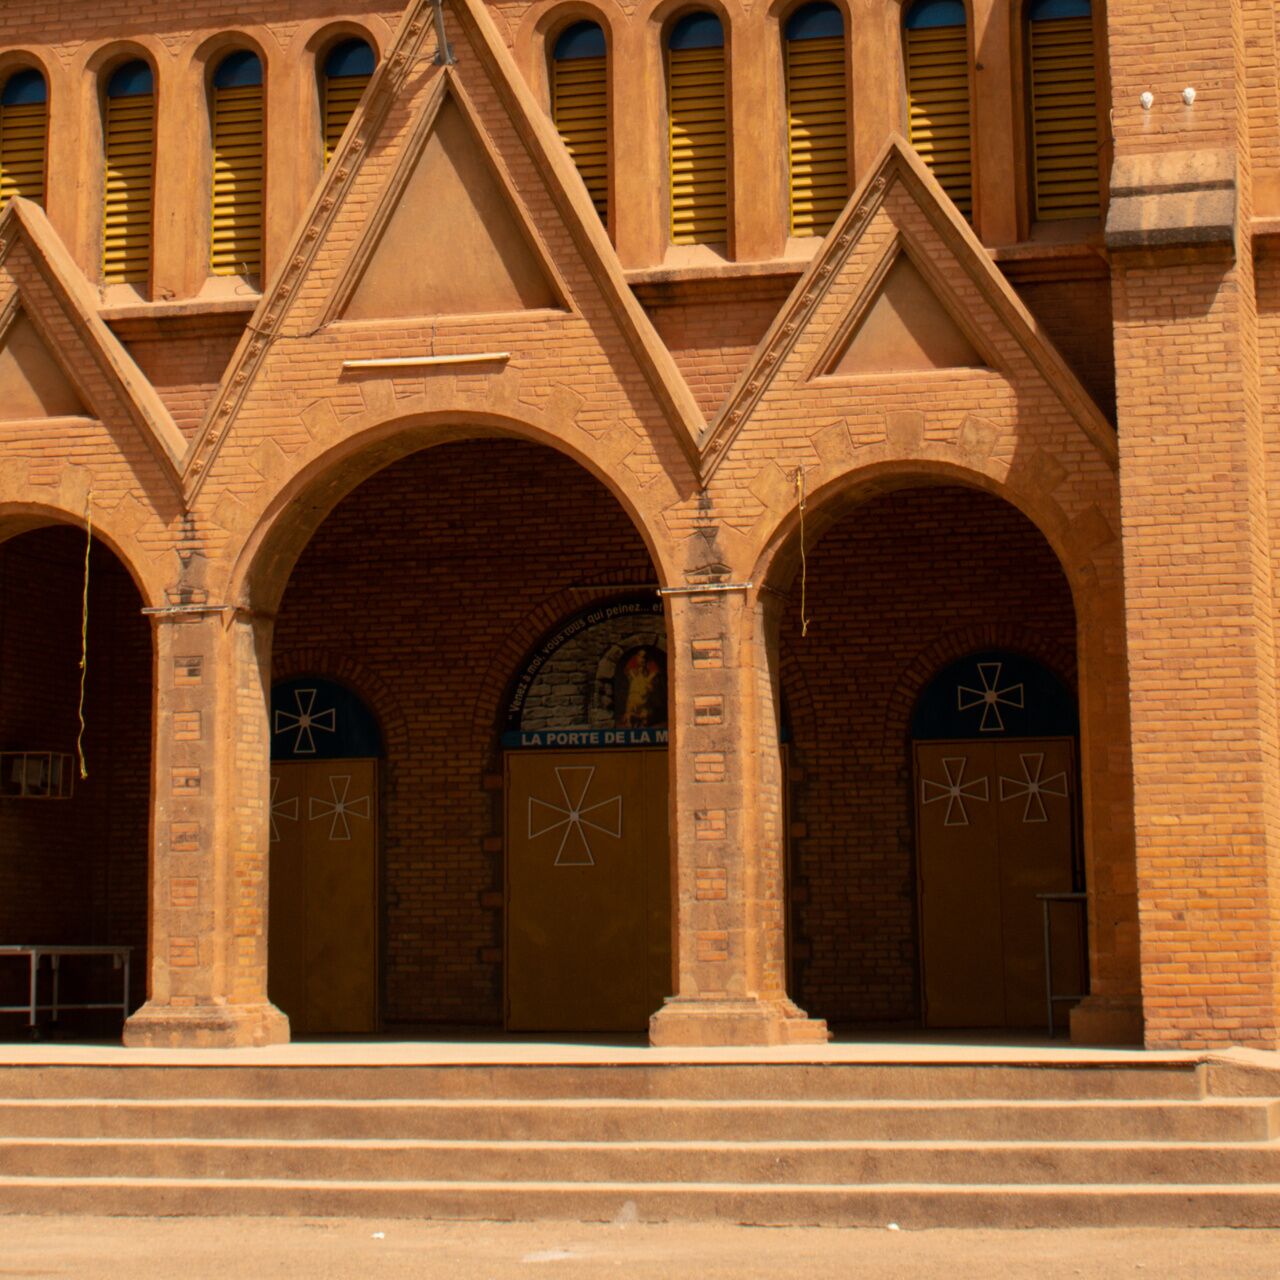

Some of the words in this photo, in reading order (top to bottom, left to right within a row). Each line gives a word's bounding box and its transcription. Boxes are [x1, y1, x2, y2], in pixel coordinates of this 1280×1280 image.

[542, 634, 565, 654] vous
[587, 609, 604, 624] qui
[521, 733, 542, 746] LA
[546, 731, 599, 745] PORTE
[604, 731, 625, 744] DE
[630, 730, 651, 743] LA
